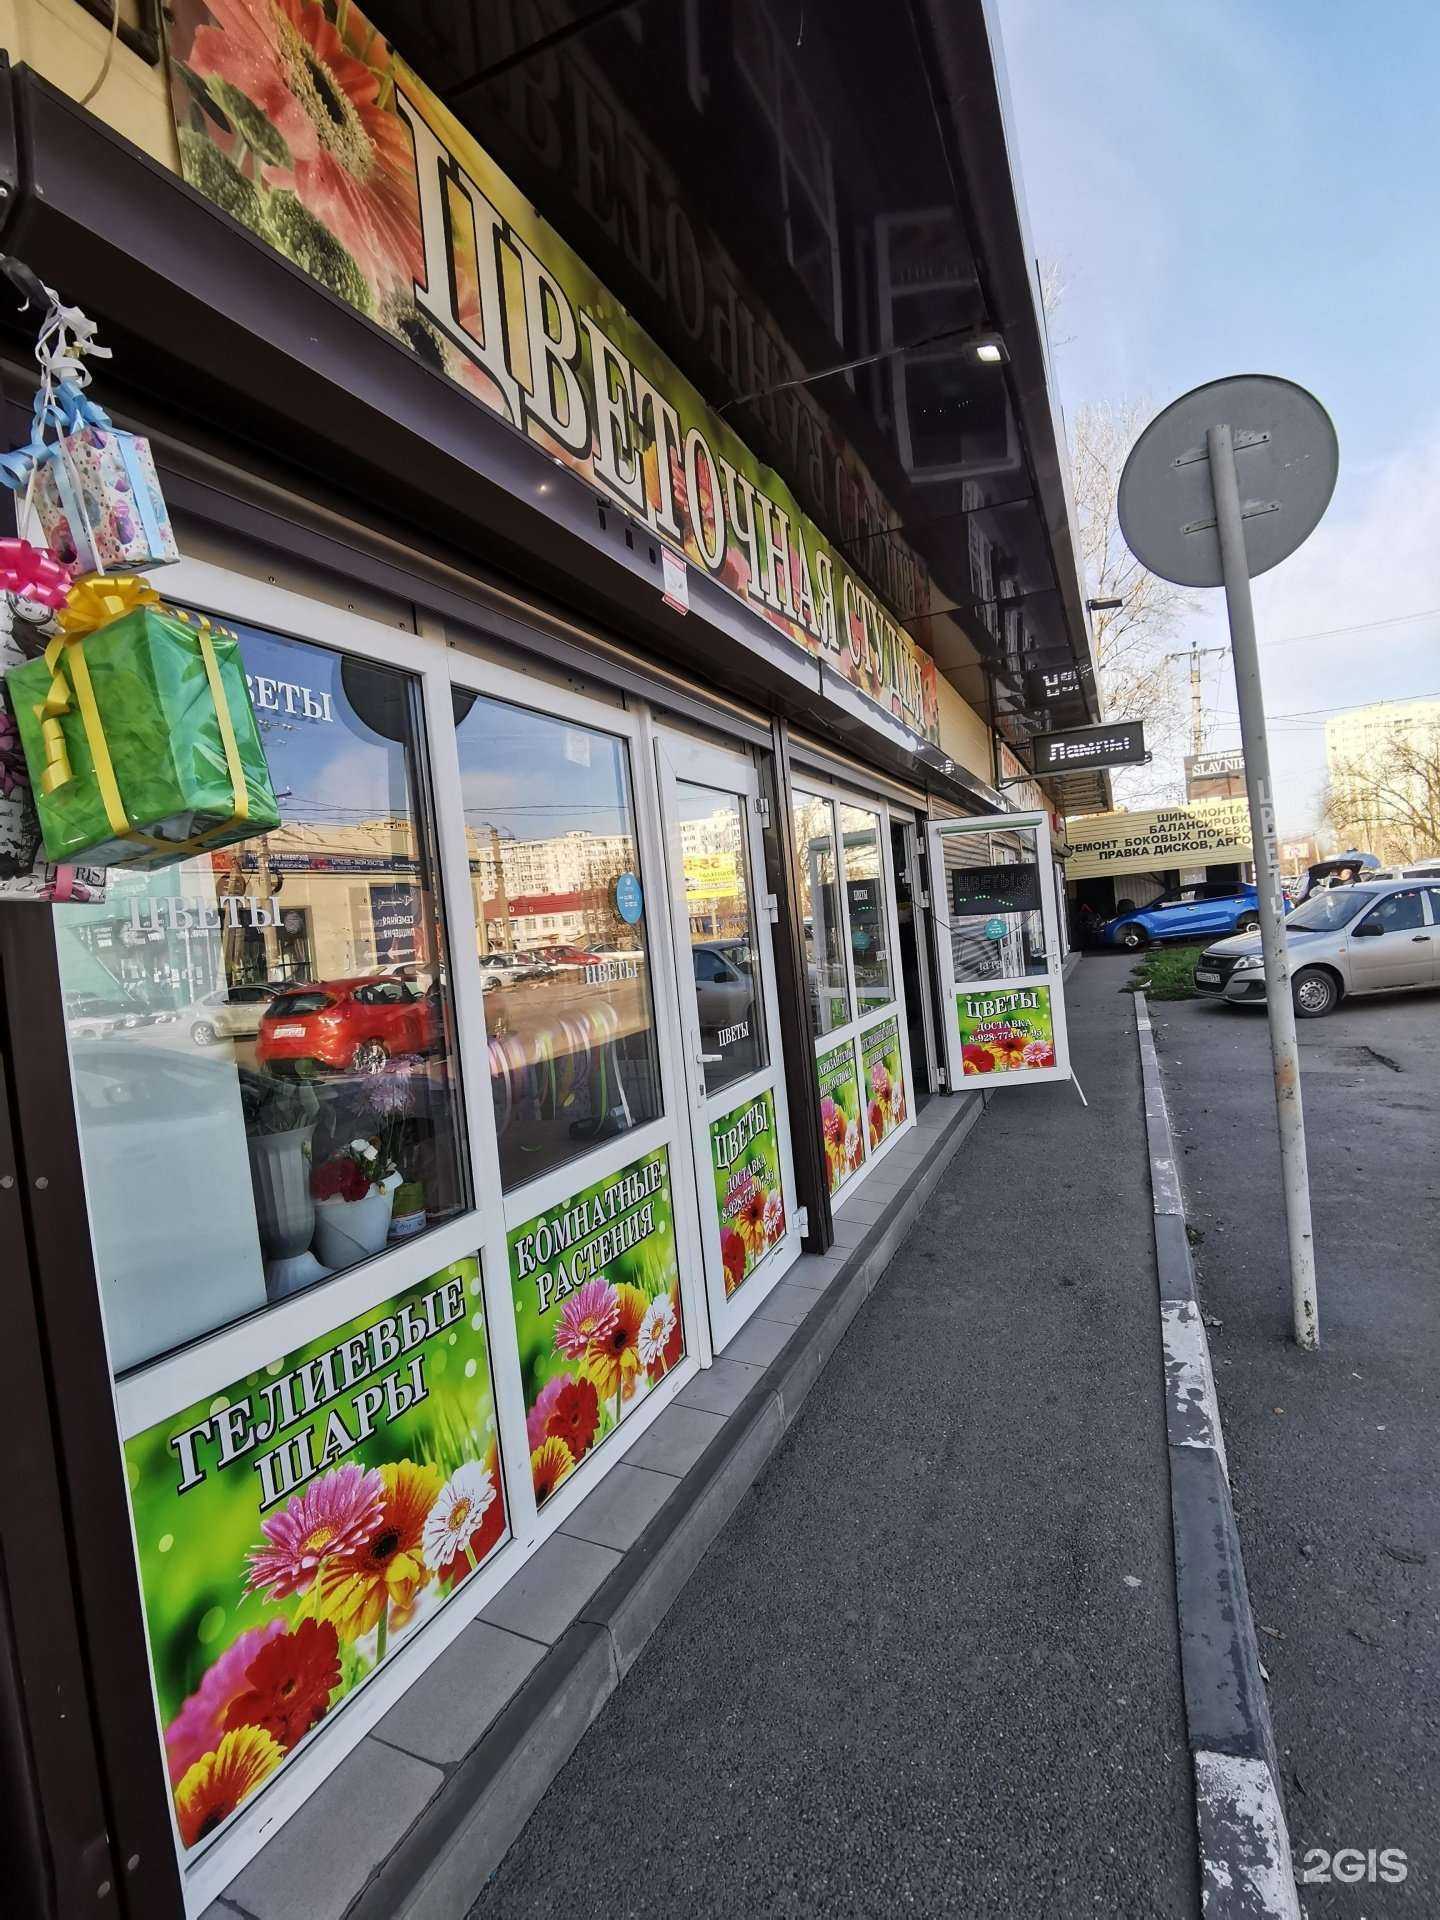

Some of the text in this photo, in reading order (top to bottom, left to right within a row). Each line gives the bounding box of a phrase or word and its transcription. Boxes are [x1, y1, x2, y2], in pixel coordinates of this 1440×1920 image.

[394, 80, 927, 733] ЦВЕТОЧНАЯ СТУДИЯ
[245, 674, 333, 722] ЕТЫ
[1149, 816, 1249, 834] БАЛАНСИРОВК
[1157, 804, 1250, 823] ШИНОМОНТА
[1099, 835, 1251, 860] ПРАВКА ДИСКОВ, АРГО
[1125, 832, 1192, 847] БОКОВЫХ
[1197, 825, 1251, 839] ПОРЕЗО
[128, 895, 285, 938] ЦВЕТЫ
[585, 959, 638, 986] ЦВЕТЫ
[966, 992, 1040, 1021] ЦВЕТЫ
[976, 1019, 1033, 1033] ДОСТАВКА
[717, 1021, 750, 1048] ЦВЕТЫ
[714, 1101, 769, 1174] ЦВЕТЫ
[727, 1152, 767, 1195] ДОСТАВКА
[515, 1160, 662, 1280] КОМНАТНЫЕ
[536, 1202, 656, 1314] РАСТЕНИЯ
[171, 1276, 467, 1496] ГЕЛИЕВЫЕ
[253, 1354, 429, 1512] ШАРЫ
